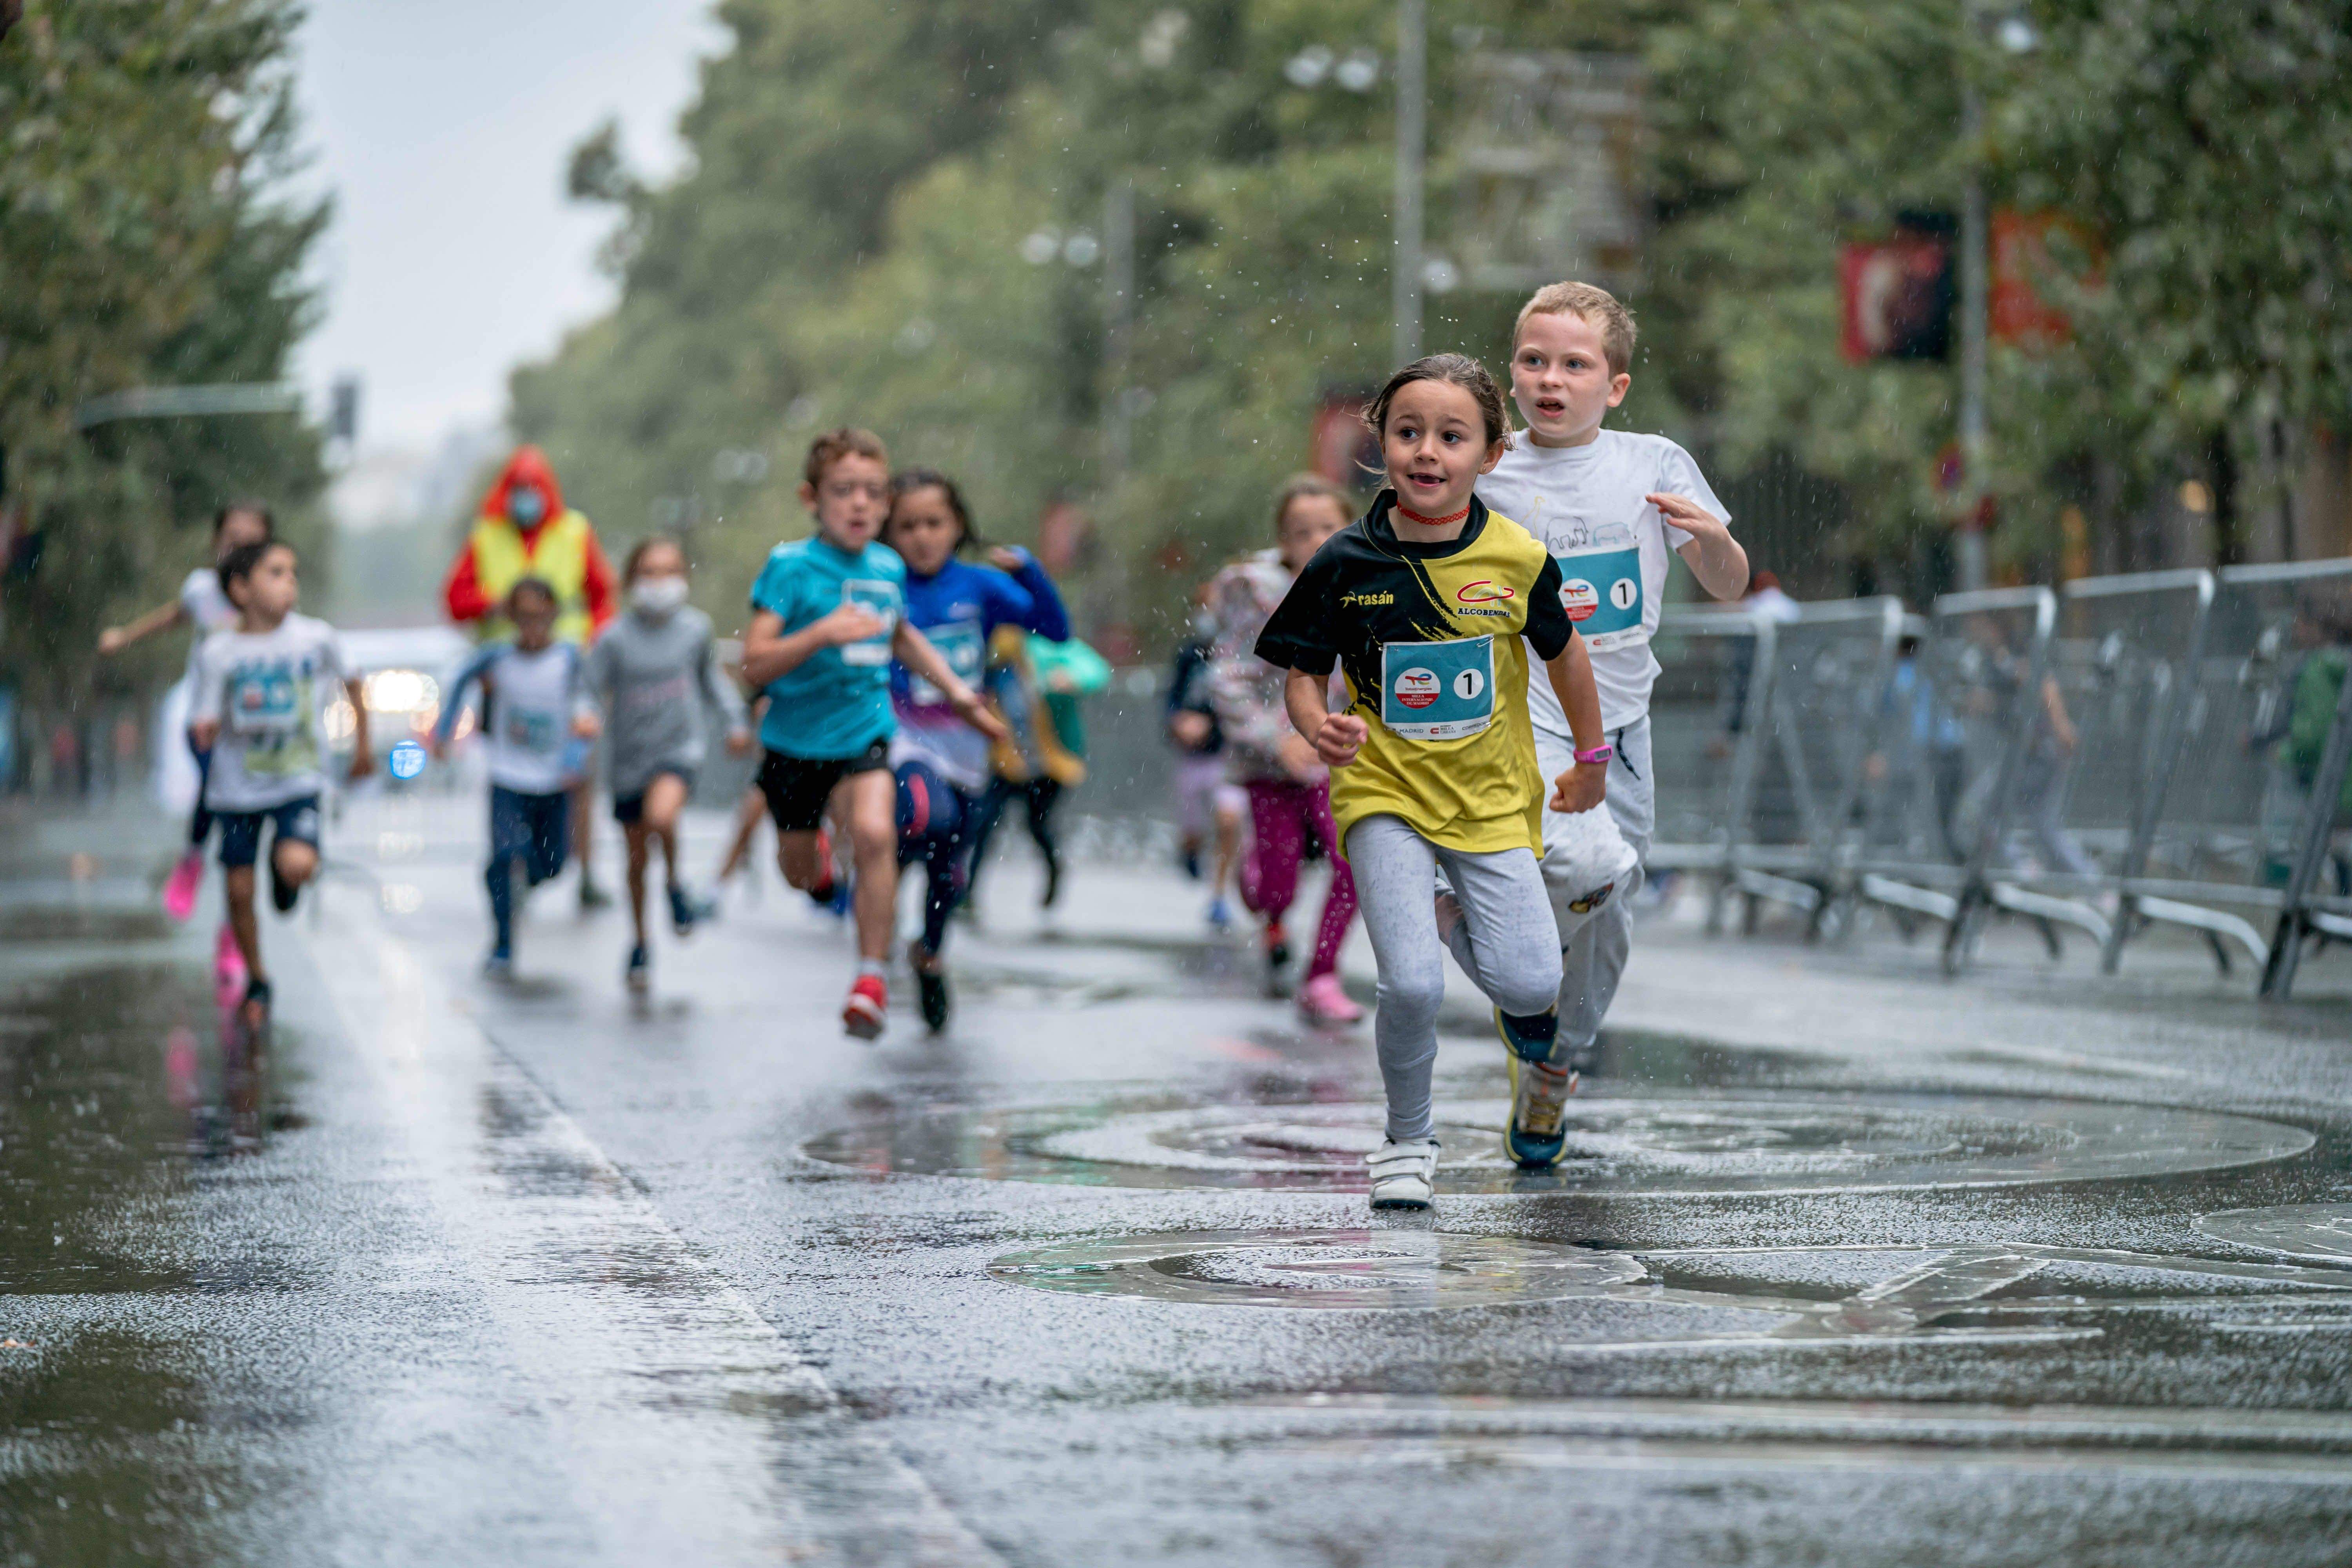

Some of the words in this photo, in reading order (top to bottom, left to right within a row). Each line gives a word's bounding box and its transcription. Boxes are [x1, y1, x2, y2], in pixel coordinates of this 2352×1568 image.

[1619, 583, 1627, 605] 1
[1457, 608, 1510, 618] ALCOBENDAS
[1463, 673, 1472, 695] 1
